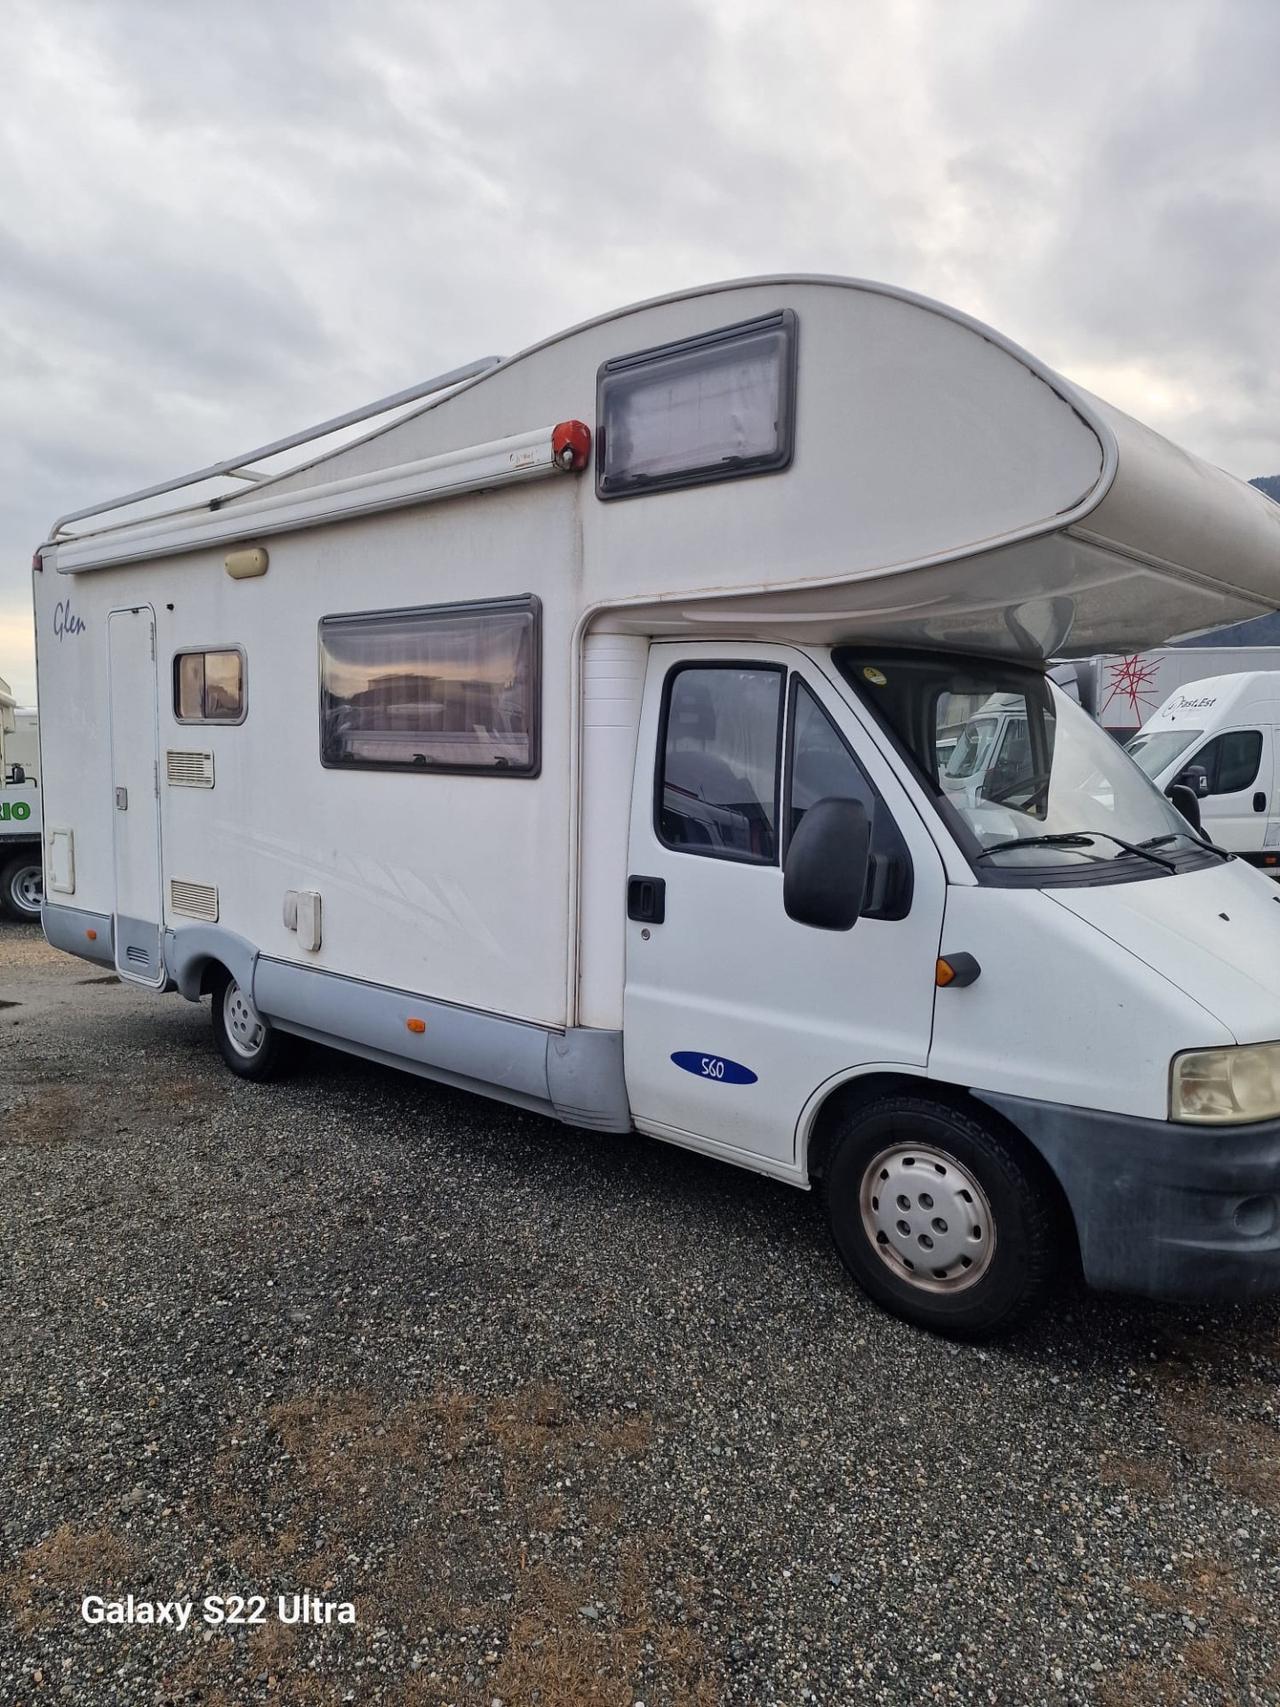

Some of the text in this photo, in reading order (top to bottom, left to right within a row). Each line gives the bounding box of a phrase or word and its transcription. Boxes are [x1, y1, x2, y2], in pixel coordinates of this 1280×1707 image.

[53, 599, 86, 642] Glen
[0, 802, 31, 820] IO
[701, 1058, 724, 1078] 560
